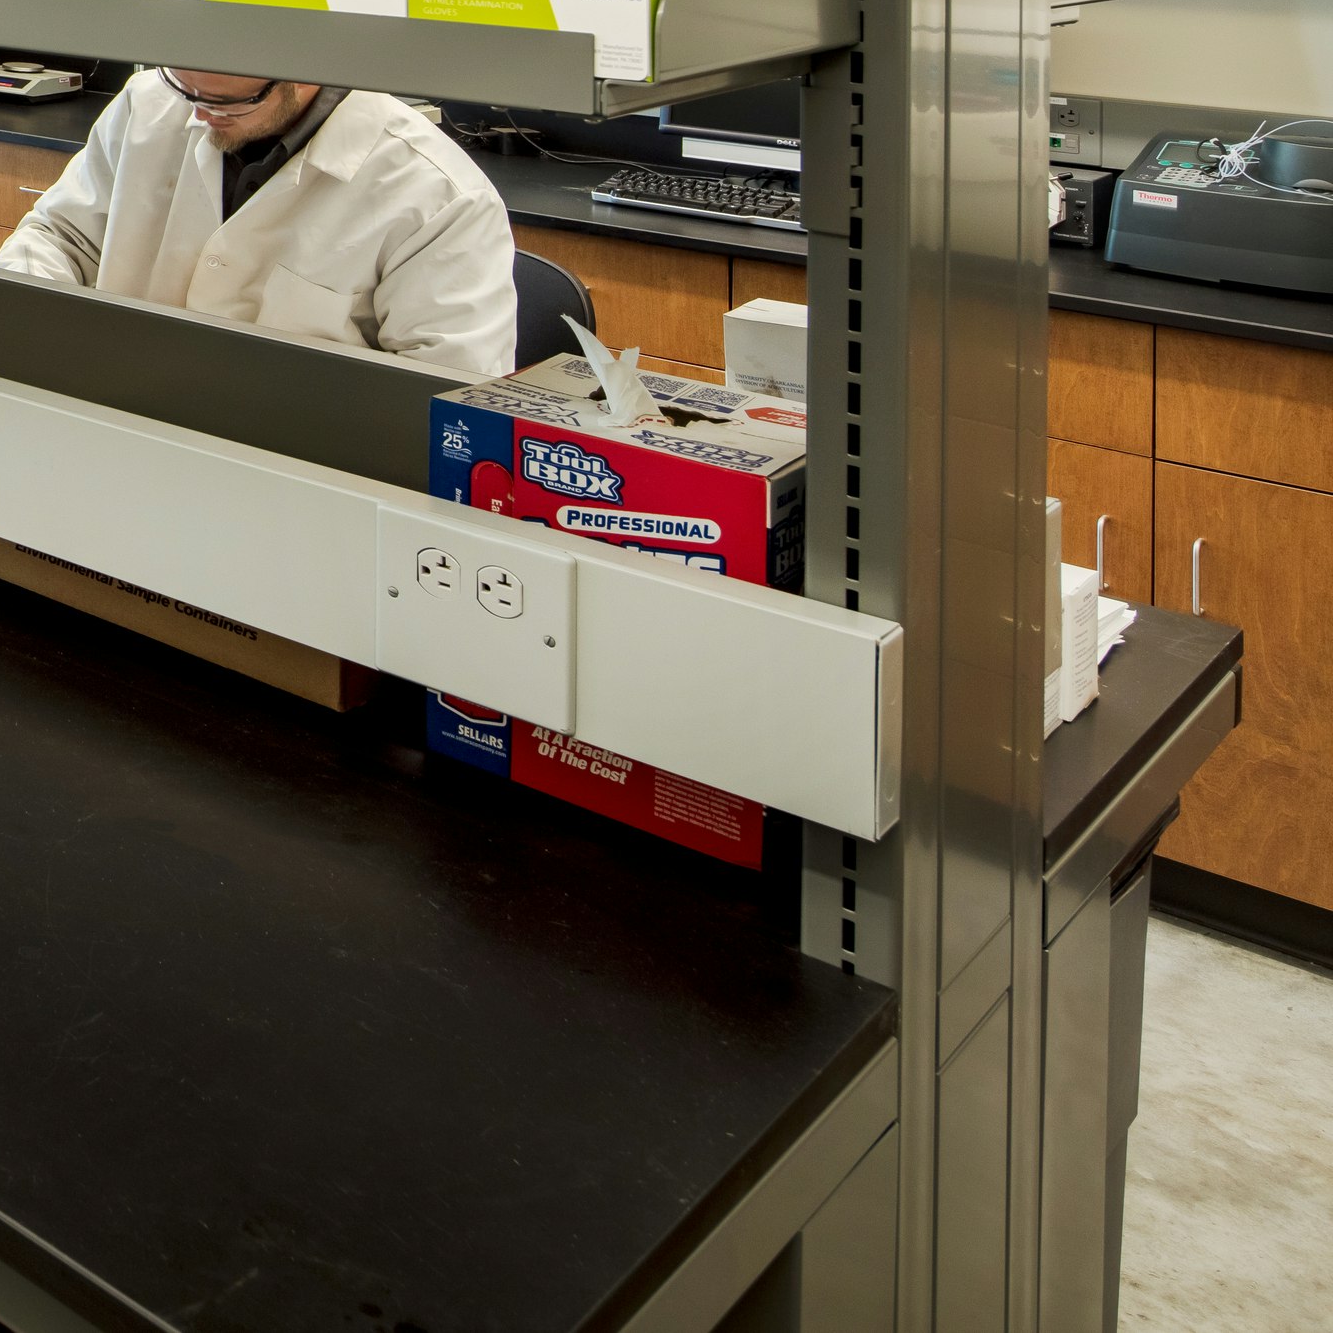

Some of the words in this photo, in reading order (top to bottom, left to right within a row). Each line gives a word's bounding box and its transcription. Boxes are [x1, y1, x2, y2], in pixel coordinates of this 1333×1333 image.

[776, 139, 798, 147] DELL
[1138, 192, 1173, 203] Thermo
[735, 372, 766, 382] UNIVERSITY
[775, 381, 805, 389] ARKANSAS
[735, 379, 759, 387] DIVISION
[527, 443, 610, 477] TOOL
[529, 459, 616, 498] BOX
[546, 480, 583, 494] BRAND
[566, 509, 715, 541] PROFESSIONAL
[116, 577, 171, 608] Sample
[173, 599, 259, 642] Containers
[441, 730, 507, 758] www.sellarscompany.com
[458, 724, 504, 750] SELLARS
[531, 726, 550, 740] At
[552, 734, 563, 746] A
[568, 737, 633, 772] Fraction
[537, 742, 557, 759] Of
[559, 748, 588, 771] The
[589, 760, 628, 785] Cost
